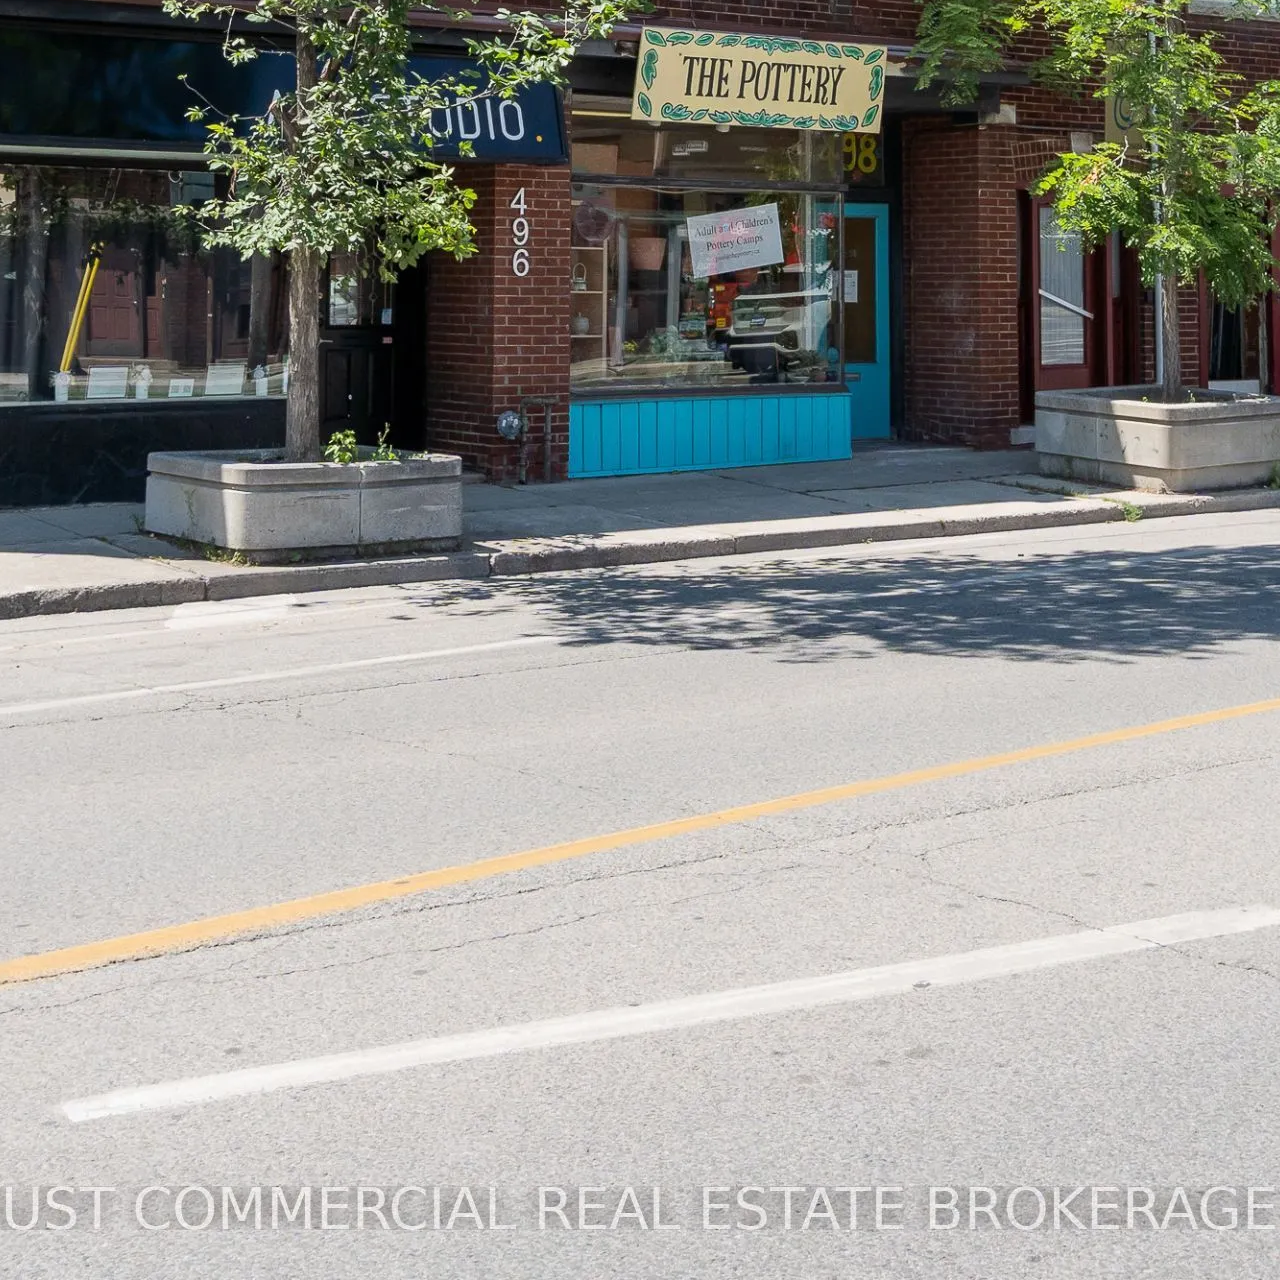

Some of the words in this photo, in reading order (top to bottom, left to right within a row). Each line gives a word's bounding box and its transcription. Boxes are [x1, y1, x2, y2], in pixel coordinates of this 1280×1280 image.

[683, 56, 733, 97] THE
[736, 60, 846, 106] POTTERY
[510, 187, 530, 276] 496
[695, 224, 717, 237] Adult
[706, 238, 735, 251] Pottery
[736, 235, 764, 247] Camps
